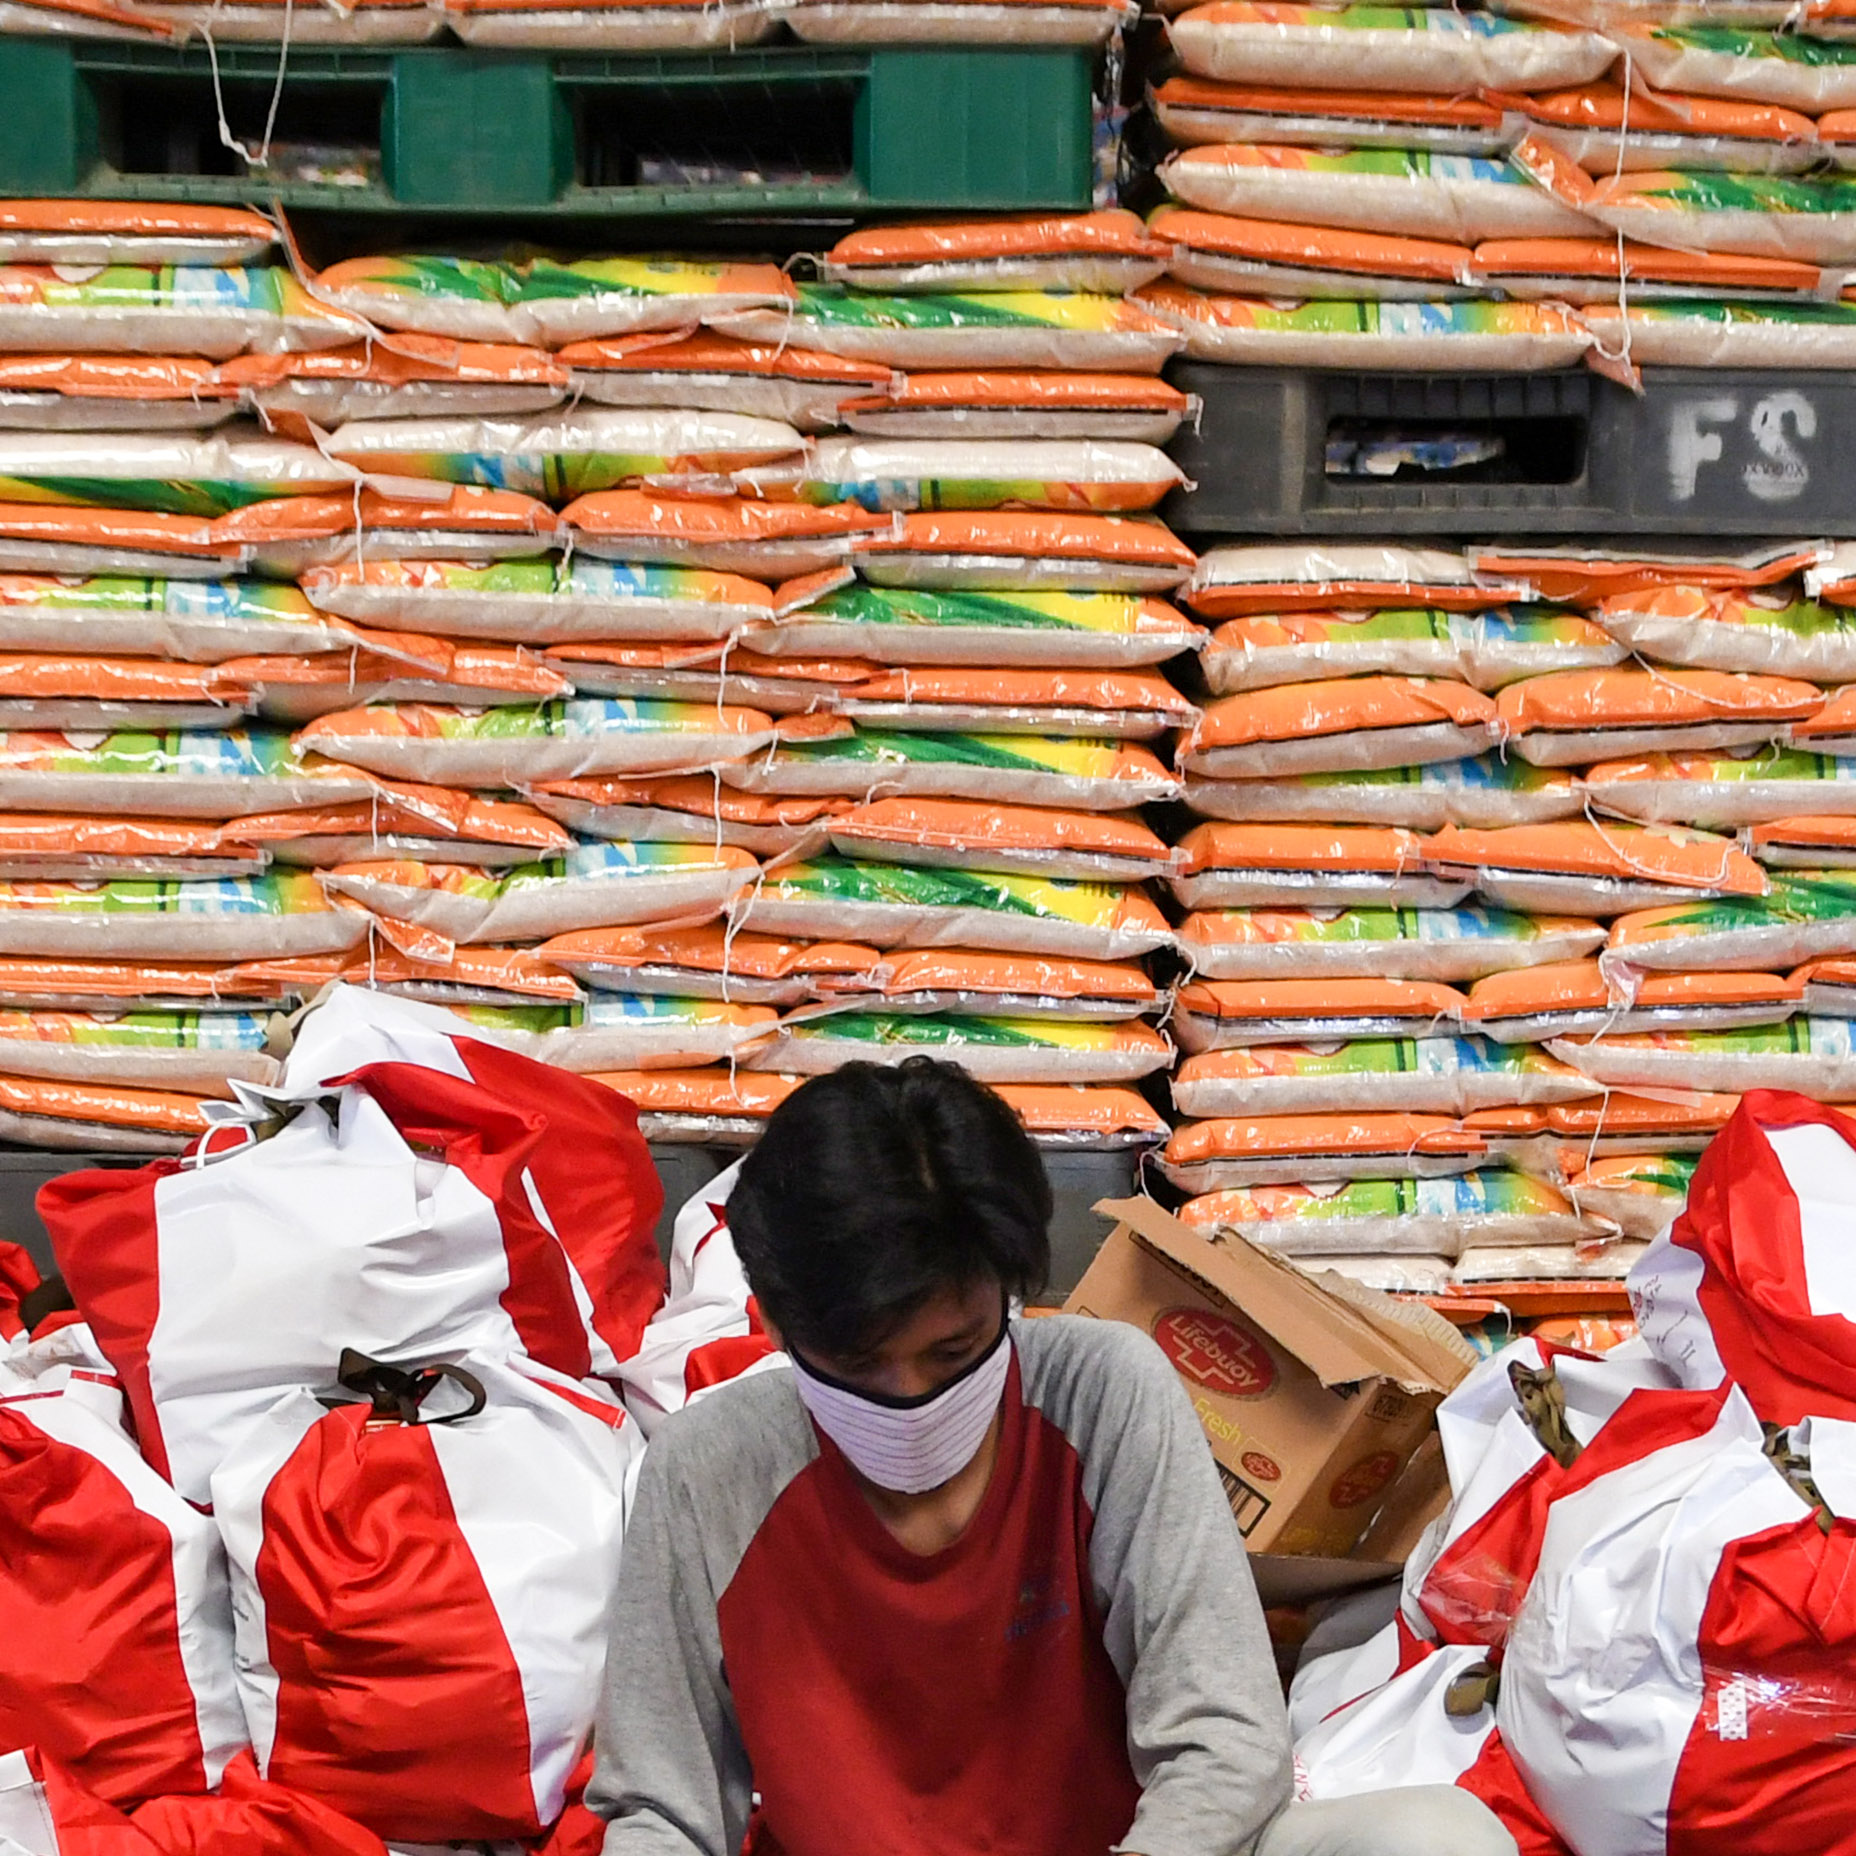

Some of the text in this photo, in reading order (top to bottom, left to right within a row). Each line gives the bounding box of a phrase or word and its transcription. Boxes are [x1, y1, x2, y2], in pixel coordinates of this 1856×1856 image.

[1668, 388, 1817, 500] FS
[1168, 1315, 1261, 1388] Lifebuoy
[1193, 1398, 1242, 1446] Fresh
